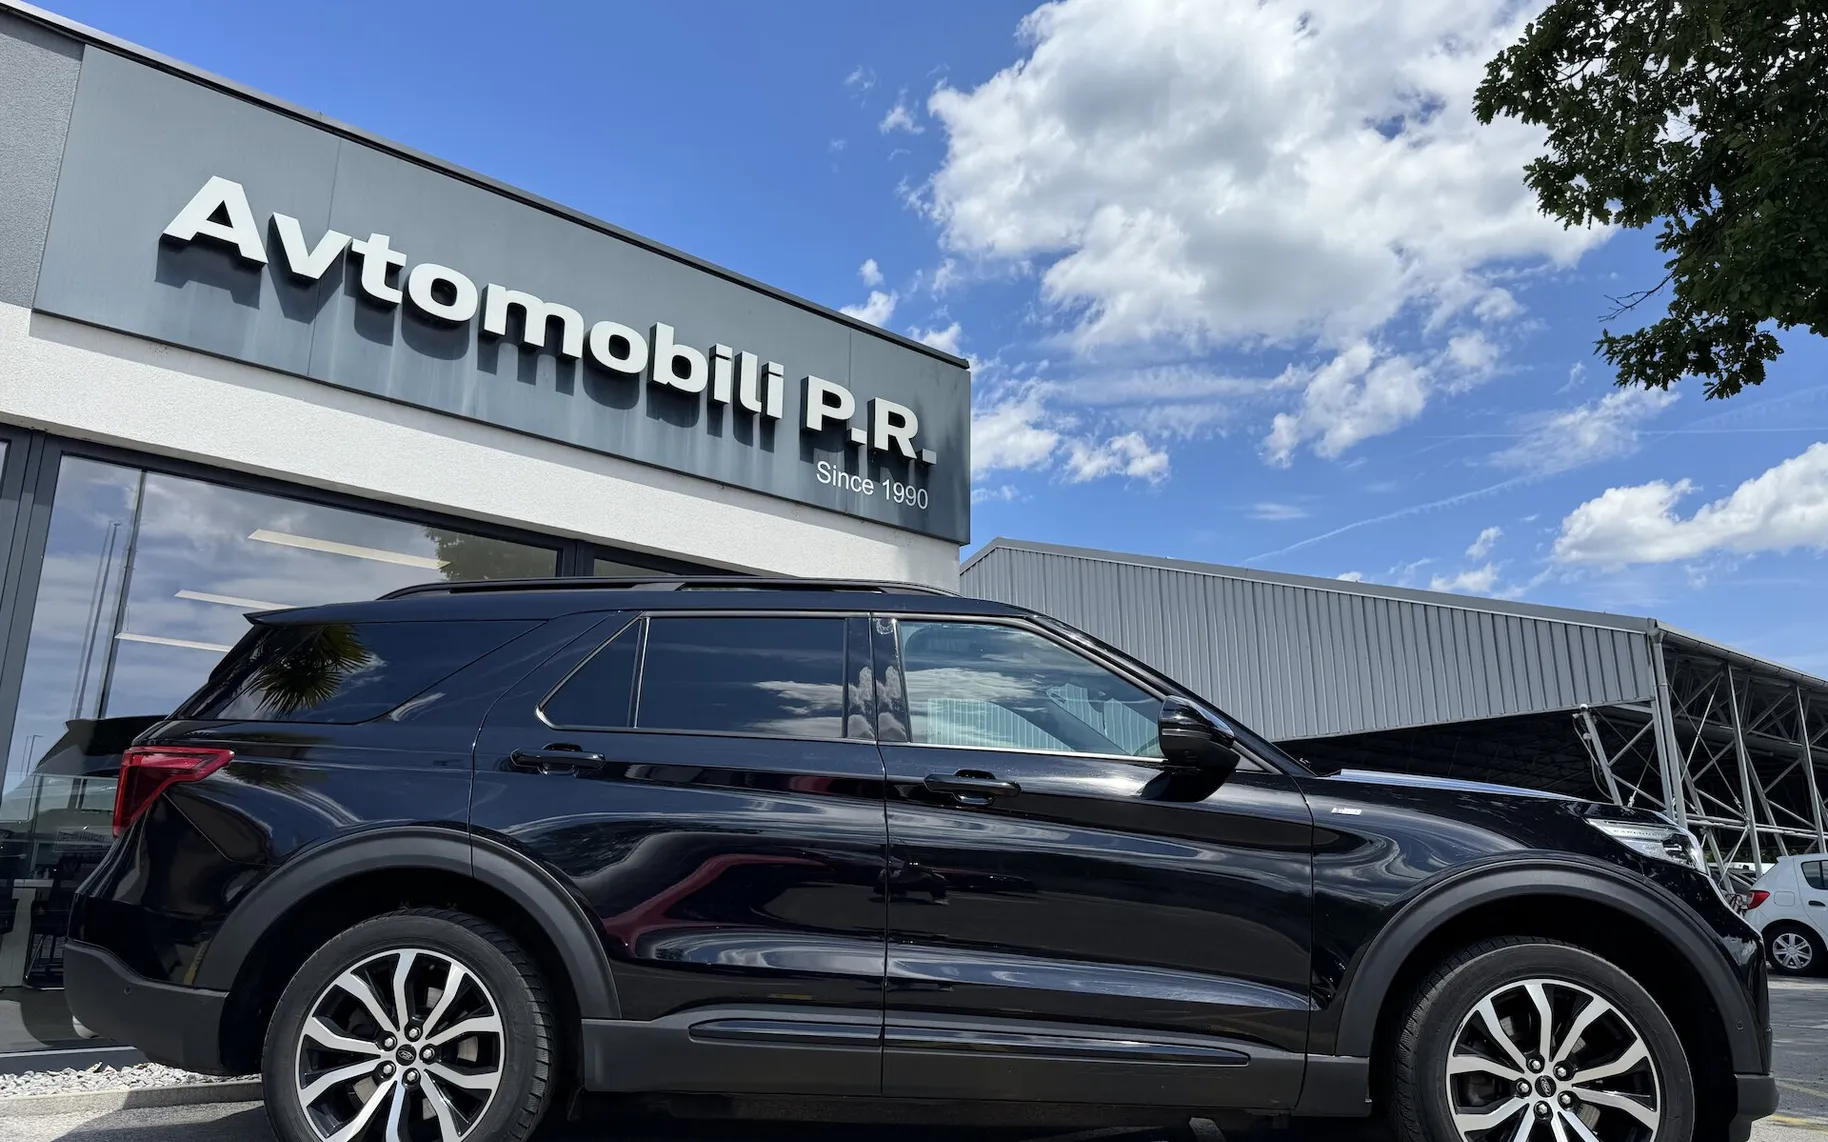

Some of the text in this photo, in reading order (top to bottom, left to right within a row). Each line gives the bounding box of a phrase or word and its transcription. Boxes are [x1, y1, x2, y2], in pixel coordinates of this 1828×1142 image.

[163, 176, 937, 464] Avtomobili P.R.
[816, 460, 928, 510] Since 1990
